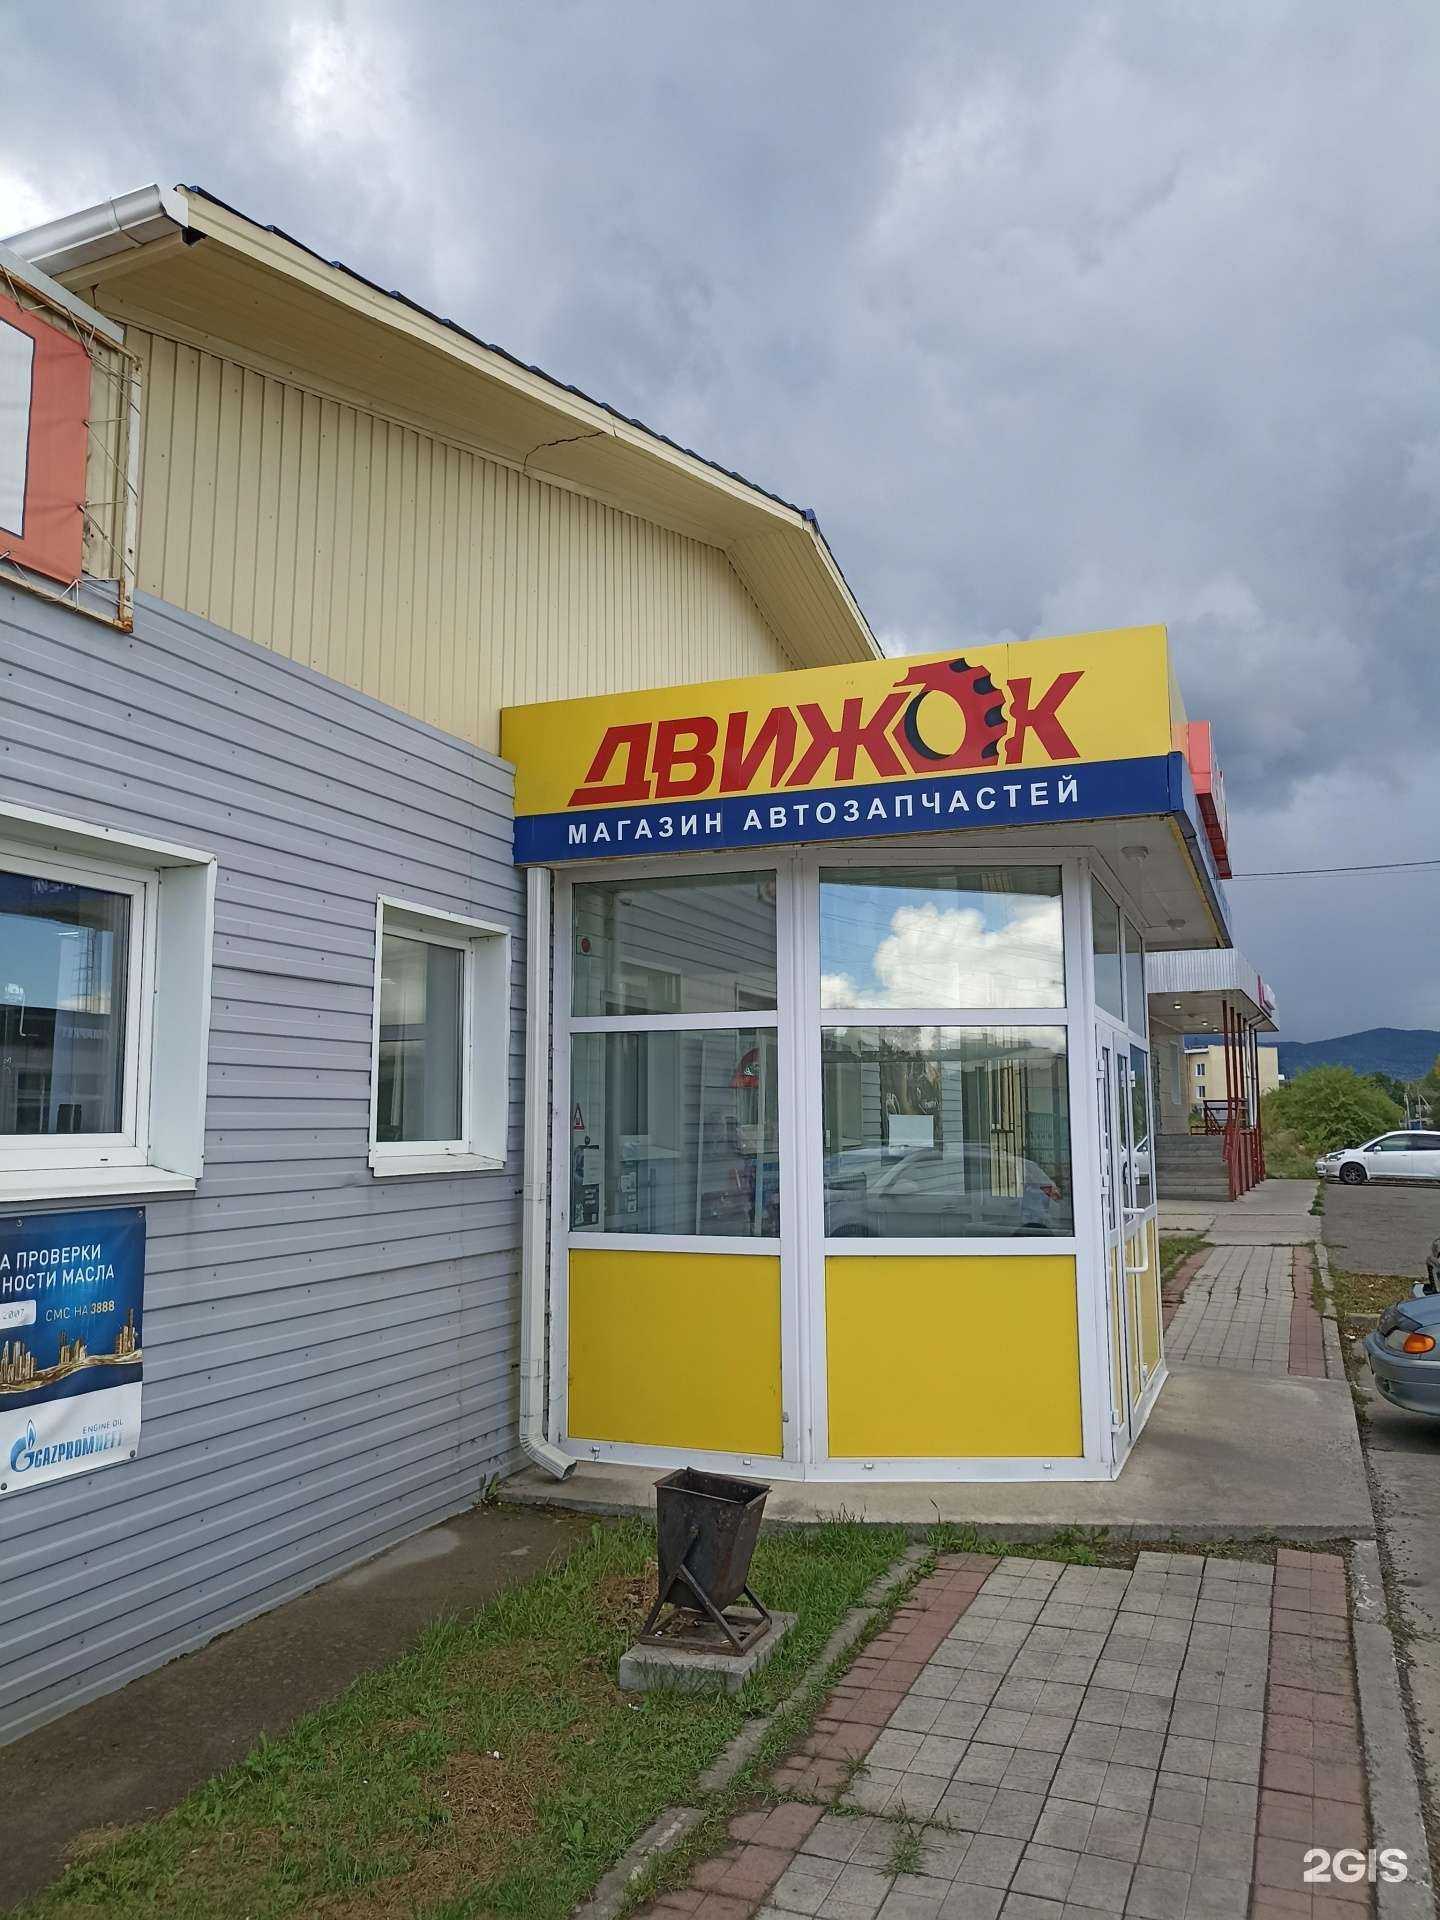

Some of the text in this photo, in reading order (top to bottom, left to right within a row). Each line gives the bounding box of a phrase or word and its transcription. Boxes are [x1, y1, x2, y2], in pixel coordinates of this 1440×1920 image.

[567, 658, 1085, 808] ДВИЖОК
[568, 774, 1079, 846] МАГАЗИН АВТОЗАПЧАСТЕЙ
[16, 1244, 101, 1271] ПРОВЕРКИ
[2, 1264, 115, 1295] НОСТИ МАСЛА
[45, 1300, 115, 1322] СМС НА 3888
